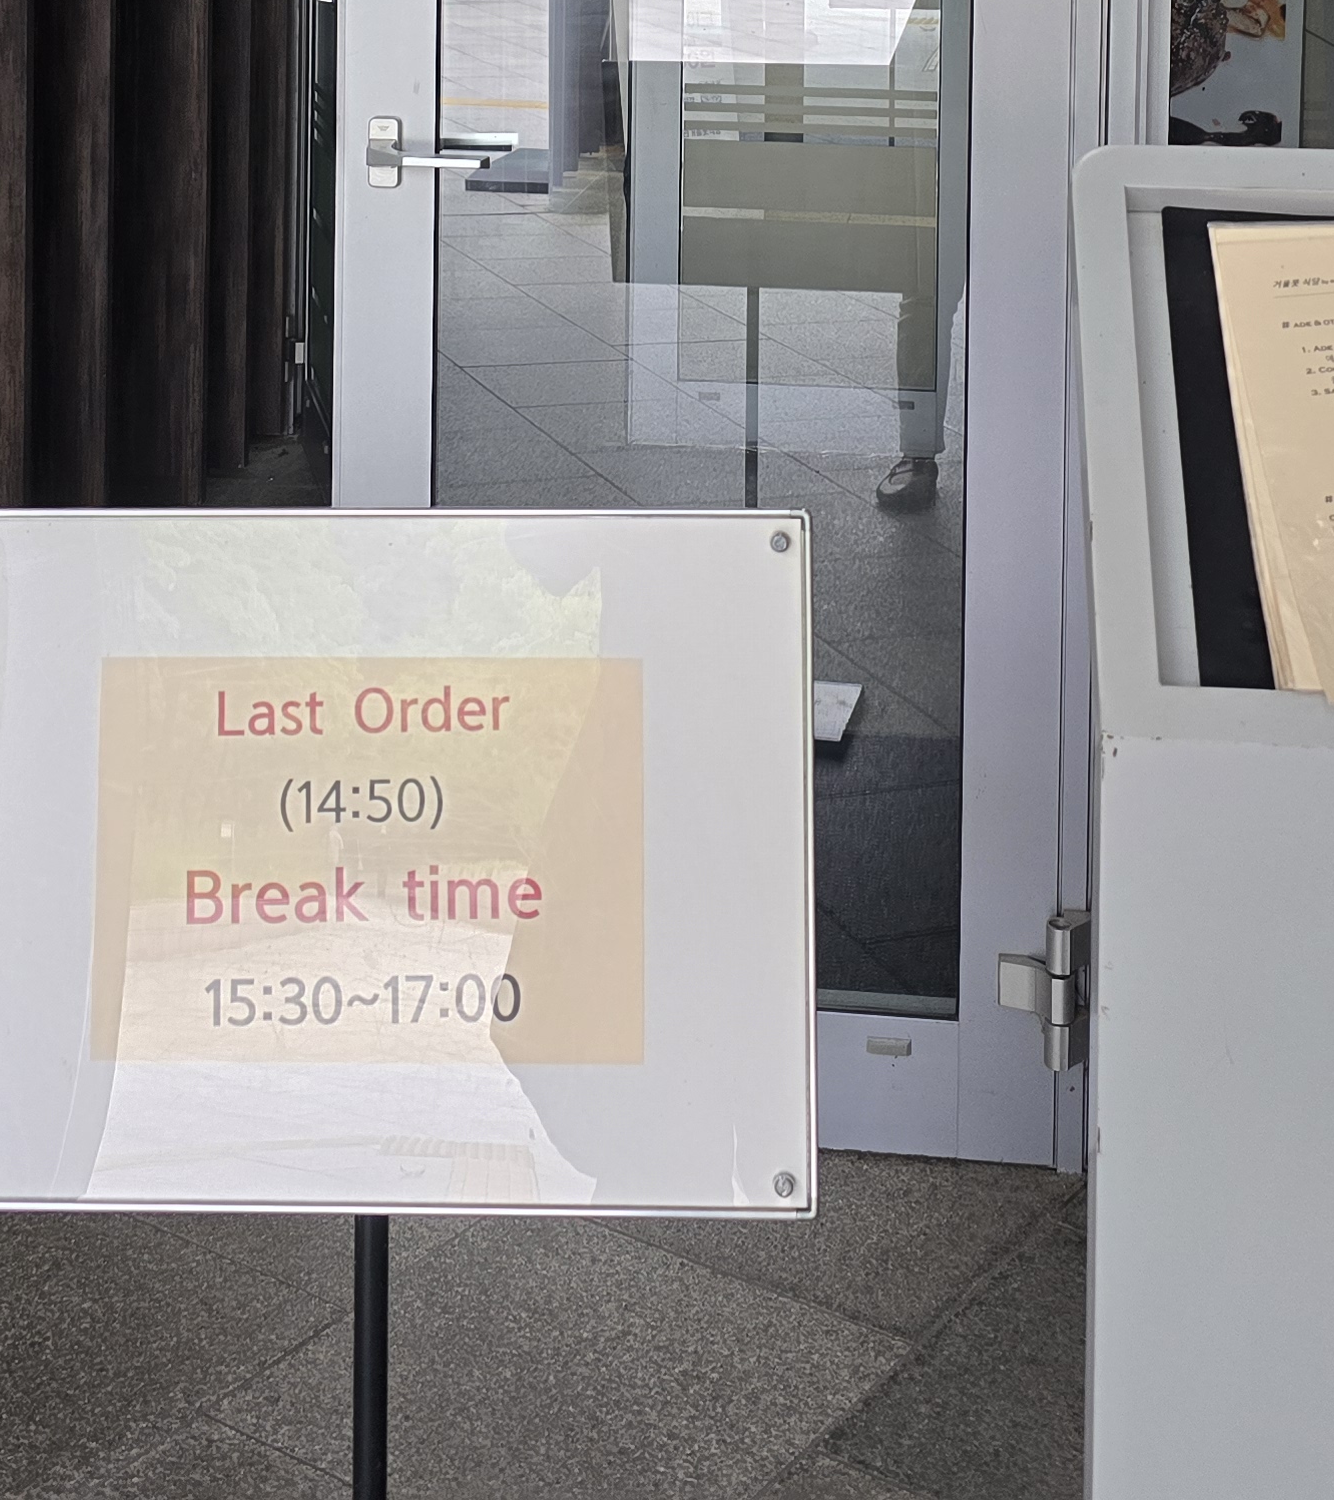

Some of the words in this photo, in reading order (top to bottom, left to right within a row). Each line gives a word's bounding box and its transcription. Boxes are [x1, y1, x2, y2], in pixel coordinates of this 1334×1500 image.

[215, 689, 325, 738] Last
[353, 686, 511, 736] Order
[278, 774, 445, 832] (14:50)
[184, 866, 366, 926] Break
[402, 864, 543, 922] time
[203, 972, 522, 1029] 15:30~17:00
